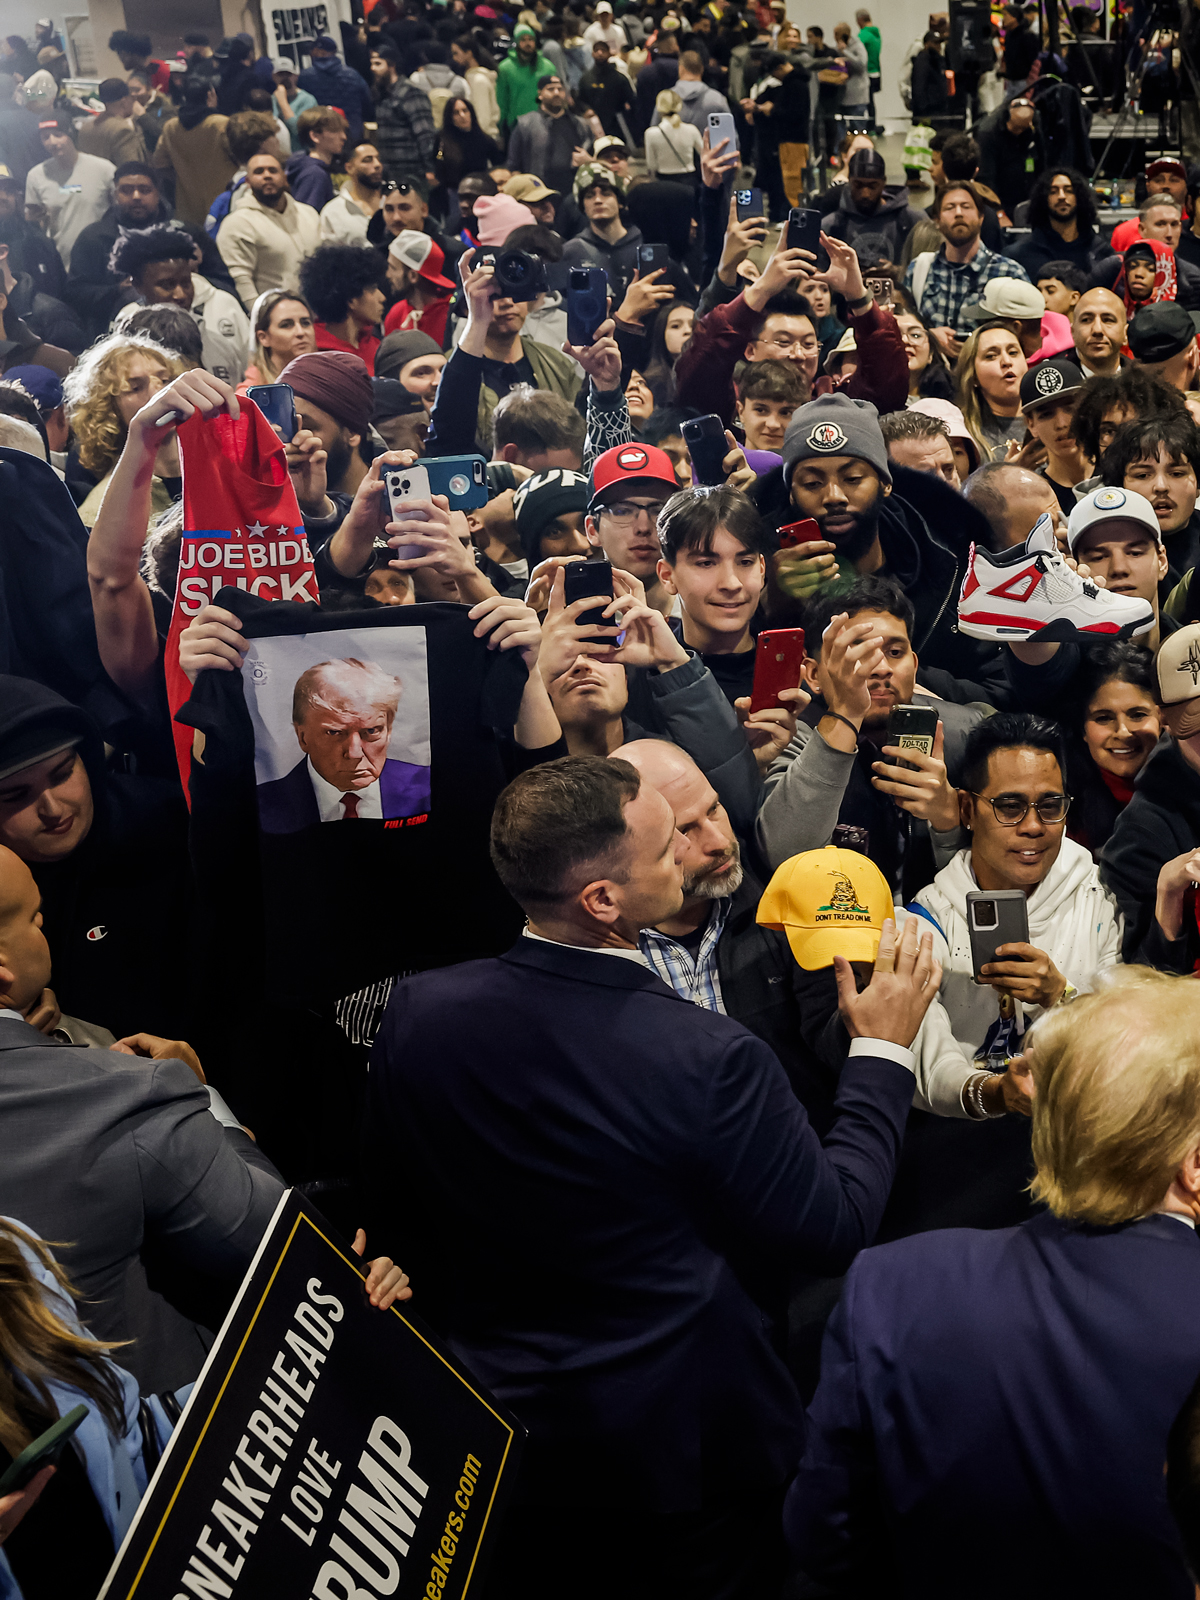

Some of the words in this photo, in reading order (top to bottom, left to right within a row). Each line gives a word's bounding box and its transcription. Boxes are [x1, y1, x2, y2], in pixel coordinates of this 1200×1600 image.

[179, 571, 320, 617] SCK
[384, 819, 404, 829] FULL
[405, 813, 428, 826] SEND
[833, 913, 855, 921] TREAD
[864, 915, 872, 923] ME
[171, 1277, 345, 1600] NEAKERHEADS
[280, 1437, 342, 1547] LOVE
[309, 1415, 430, 1600] RUMP
[422, 1453, 483, 1600] eakers.com
